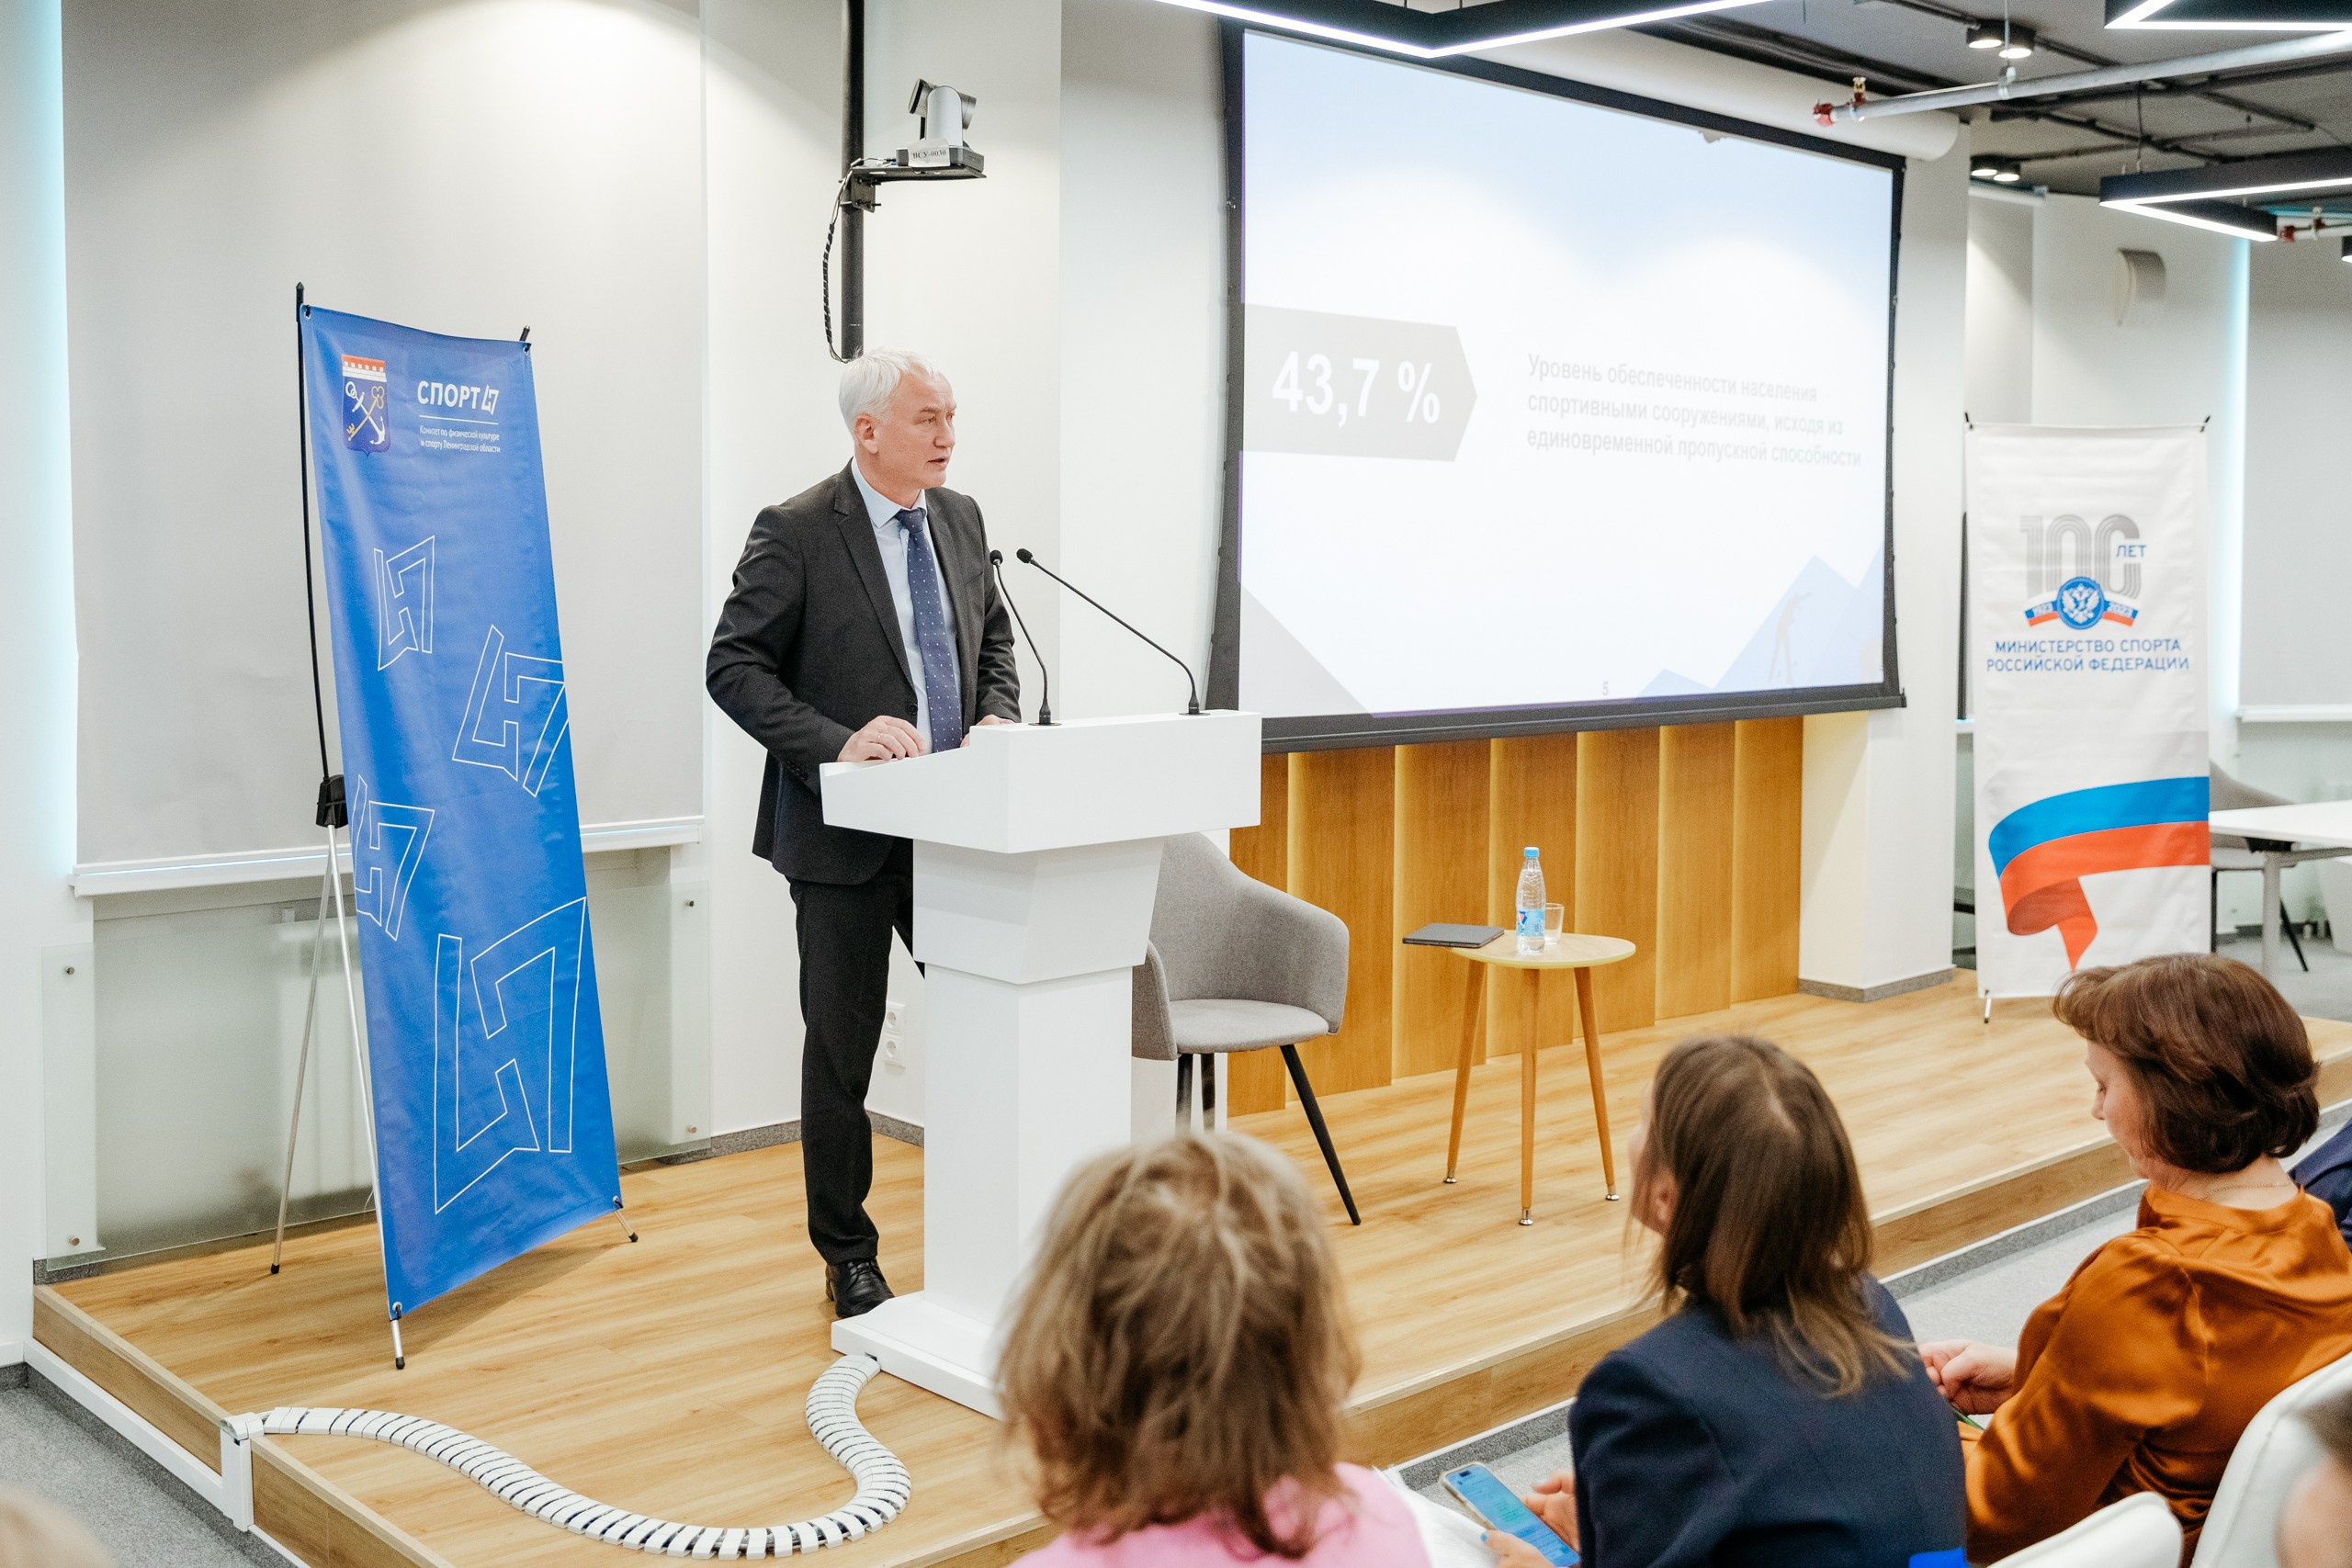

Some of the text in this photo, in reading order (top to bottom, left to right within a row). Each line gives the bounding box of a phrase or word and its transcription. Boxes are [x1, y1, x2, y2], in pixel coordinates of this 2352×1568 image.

[417, 380, 481, 410] СПОРТ
[1272, 351, 1441, 428] 43,7 %
[1528, 353, 1818, 402] Уровень обеспеченности населения
[1528, 394, 1844, 437] спортивными сооружениями, исходя из
[1527, 428, 1862, 468] единовременной пропускной способности
[2116, 545, 2147, 558] ЛЕТ
[1995, 638, 2181, 653] МИНИСТЕРСТВО СПОРТА
[1986, 655, 2190, 672] РОССИЙСКОЙ ФЕДЕРАЦИИ
